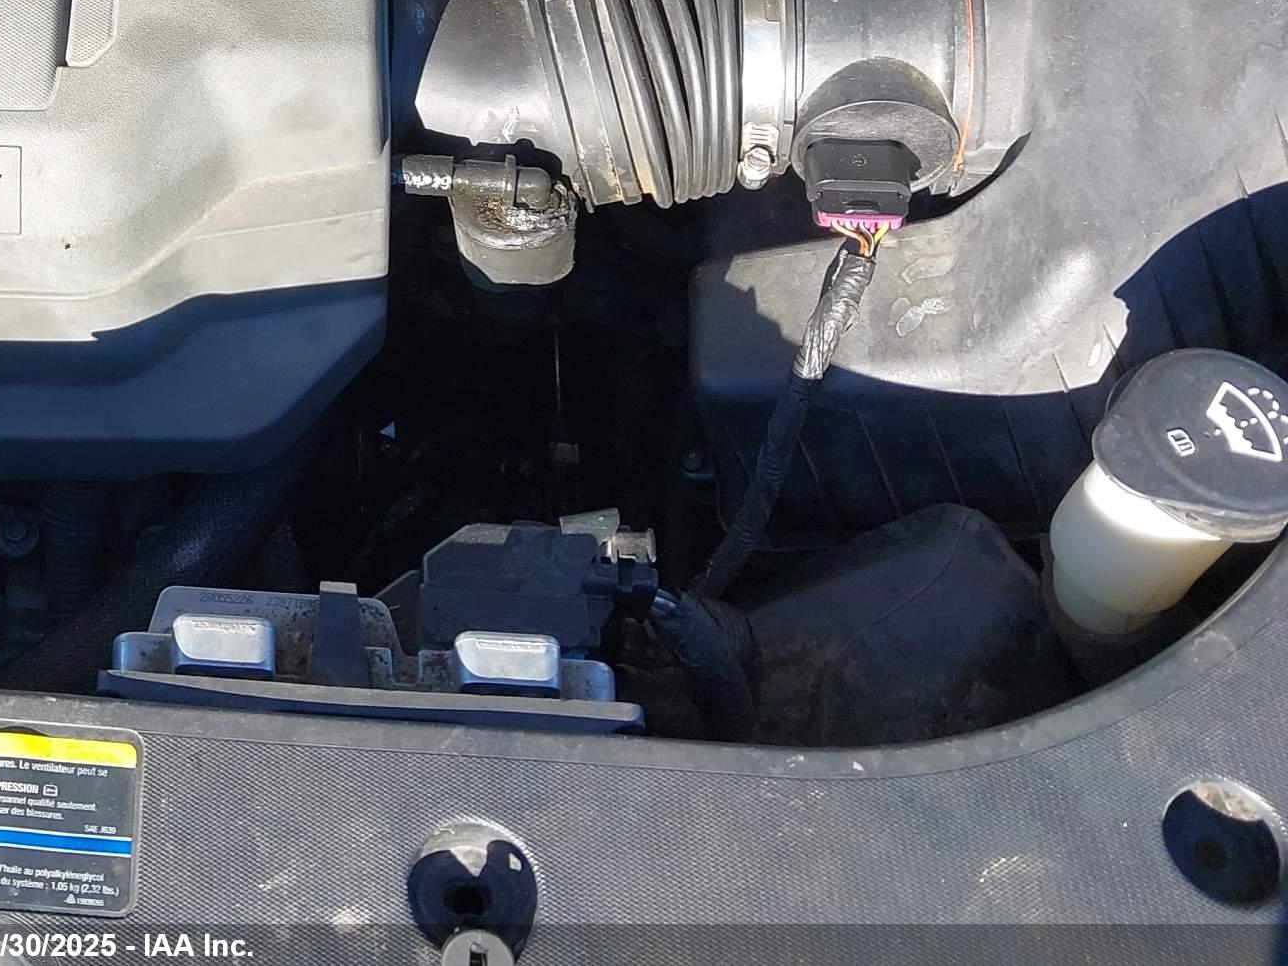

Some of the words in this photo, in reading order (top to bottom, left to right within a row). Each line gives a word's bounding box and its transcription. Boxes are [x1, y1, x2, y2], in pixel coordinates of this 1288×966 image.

[19, 760, 30, 770] Le
[31, 762, 75, 774] ventilateur
[76, 766, 96, 776] peut
[97, 768, 108, 777] se
[11, 807, 25, 816] des
[26, 808, 64, 820] blessures.
[84, 824, 99, 833] SAE
[23, 868, 33, 876] au
[0, 877, 10, 885] du
[69, 883, 80, 894] kg
